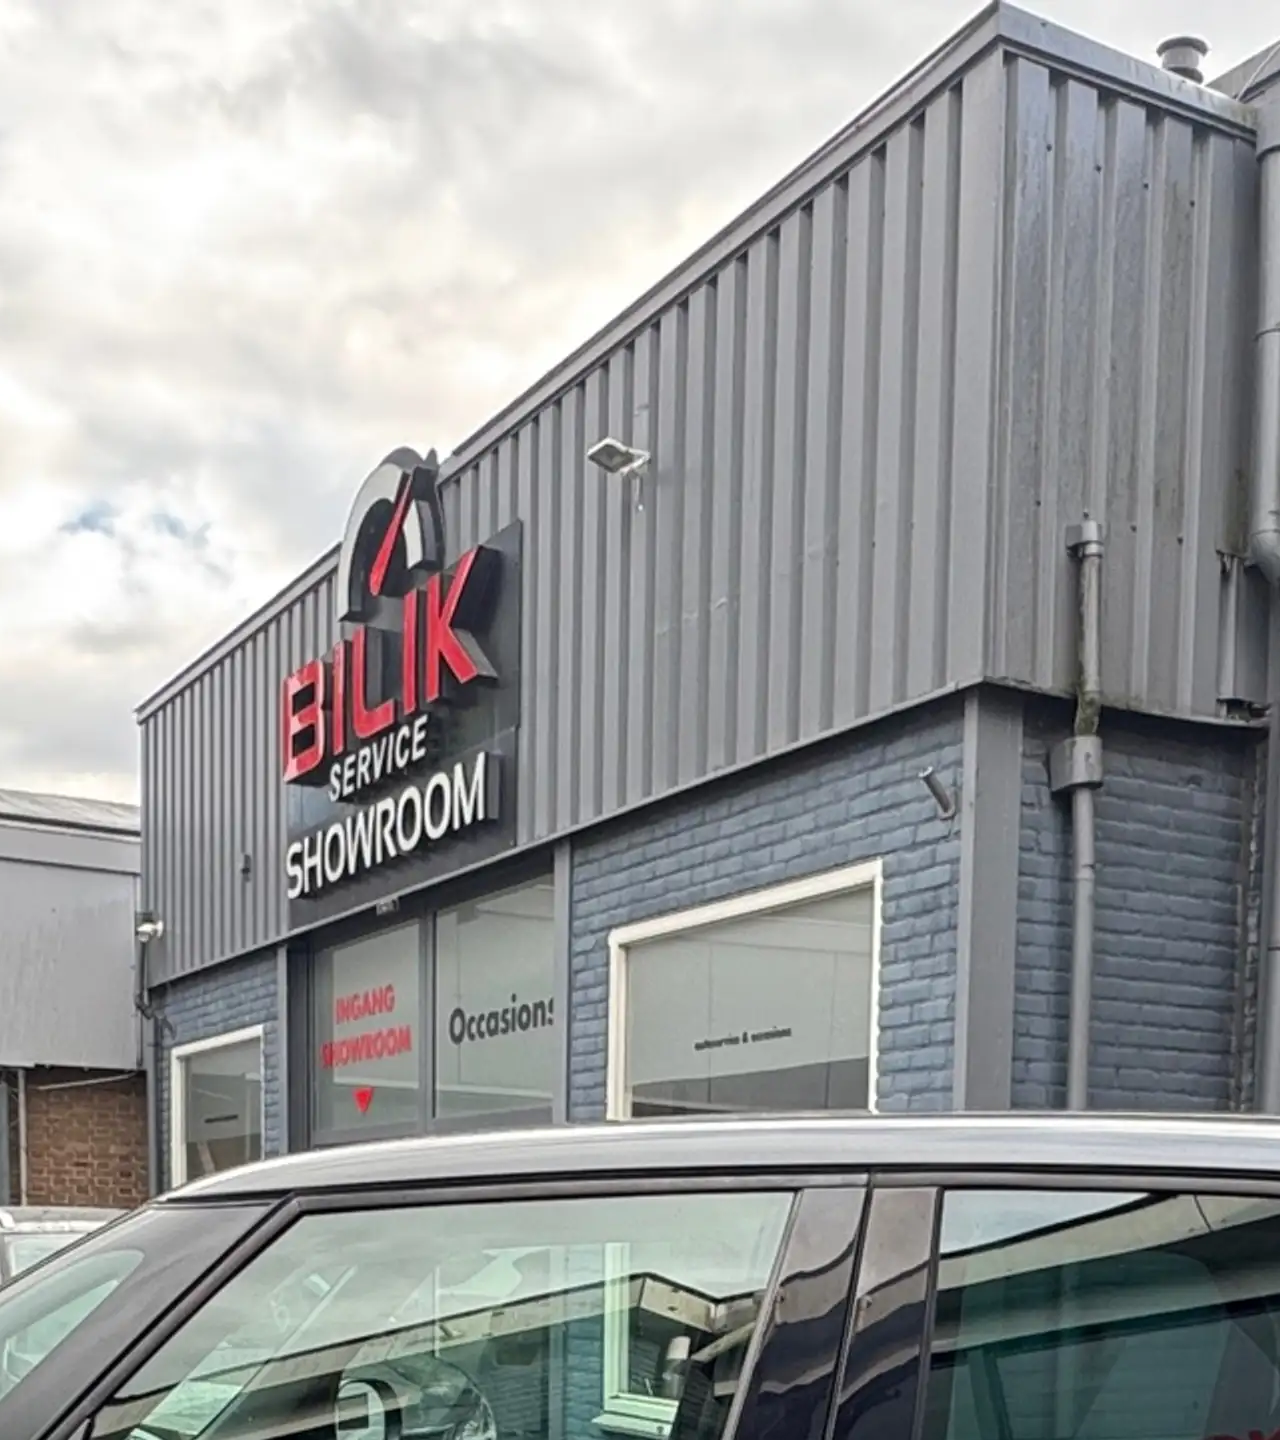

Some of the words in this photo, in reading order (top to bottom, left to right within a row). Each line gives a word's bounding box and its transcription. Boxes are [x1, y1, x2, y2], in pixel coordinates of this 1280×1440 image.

[283, 545, 479, 783] BILIK
[328, 713, 429, 802] SERVICE
[286, 751, 487, 899] SHOWROOM
[334, 983, 396, 1026] INGANG
